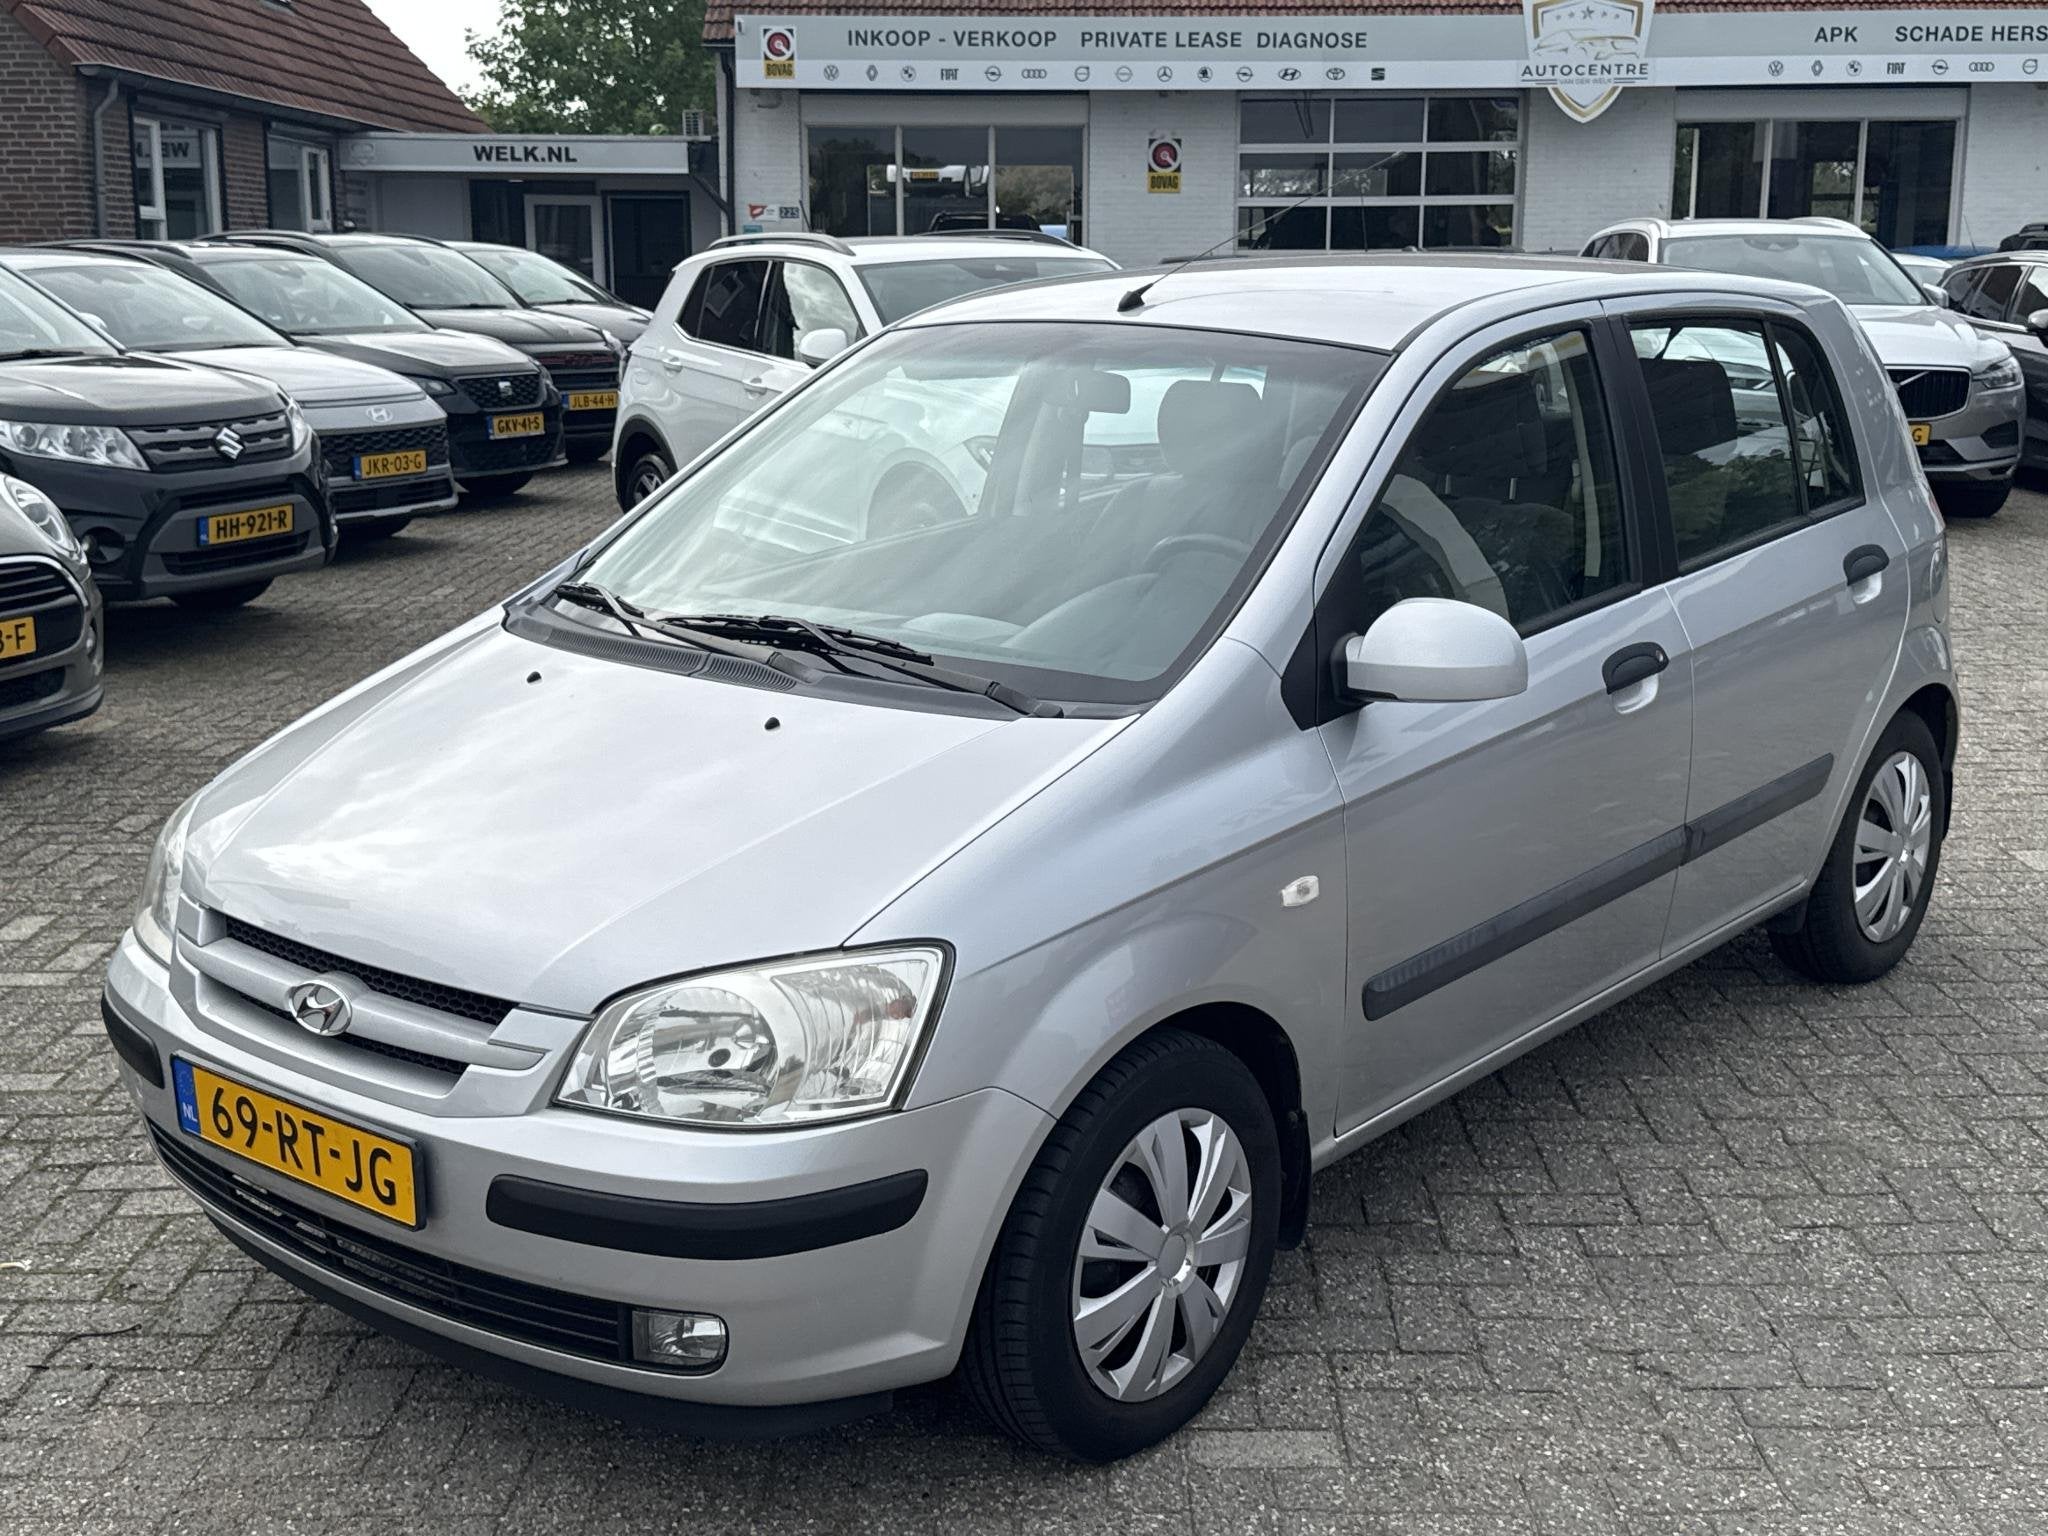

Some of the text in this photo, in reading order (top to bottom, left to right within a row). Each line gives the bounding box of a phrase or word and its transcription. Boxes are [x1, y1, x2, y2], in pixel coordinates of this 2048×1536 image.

[848, 30, 930, 47] INKOOP
[953, 30, 1057, 48] VERKOOP
[1081, 31, 1167, 48] PRIVATE
[1175, 31, 1242, 48] LEASE
[1256, 32, 1367, 49] DIAGNOSE
[1814, 25, 2048, 43] APK SCHADE HERS
[1521, 63, 1649, 77] AUTOCENTRE
[473, 145, 578, 163] WELK.NL
[366, 453, 422, 476] JKR-03-G
[216, 510, 287, 539] HH-921-R
[182, 1087, 397, 1206] NL 69-RT-JG
